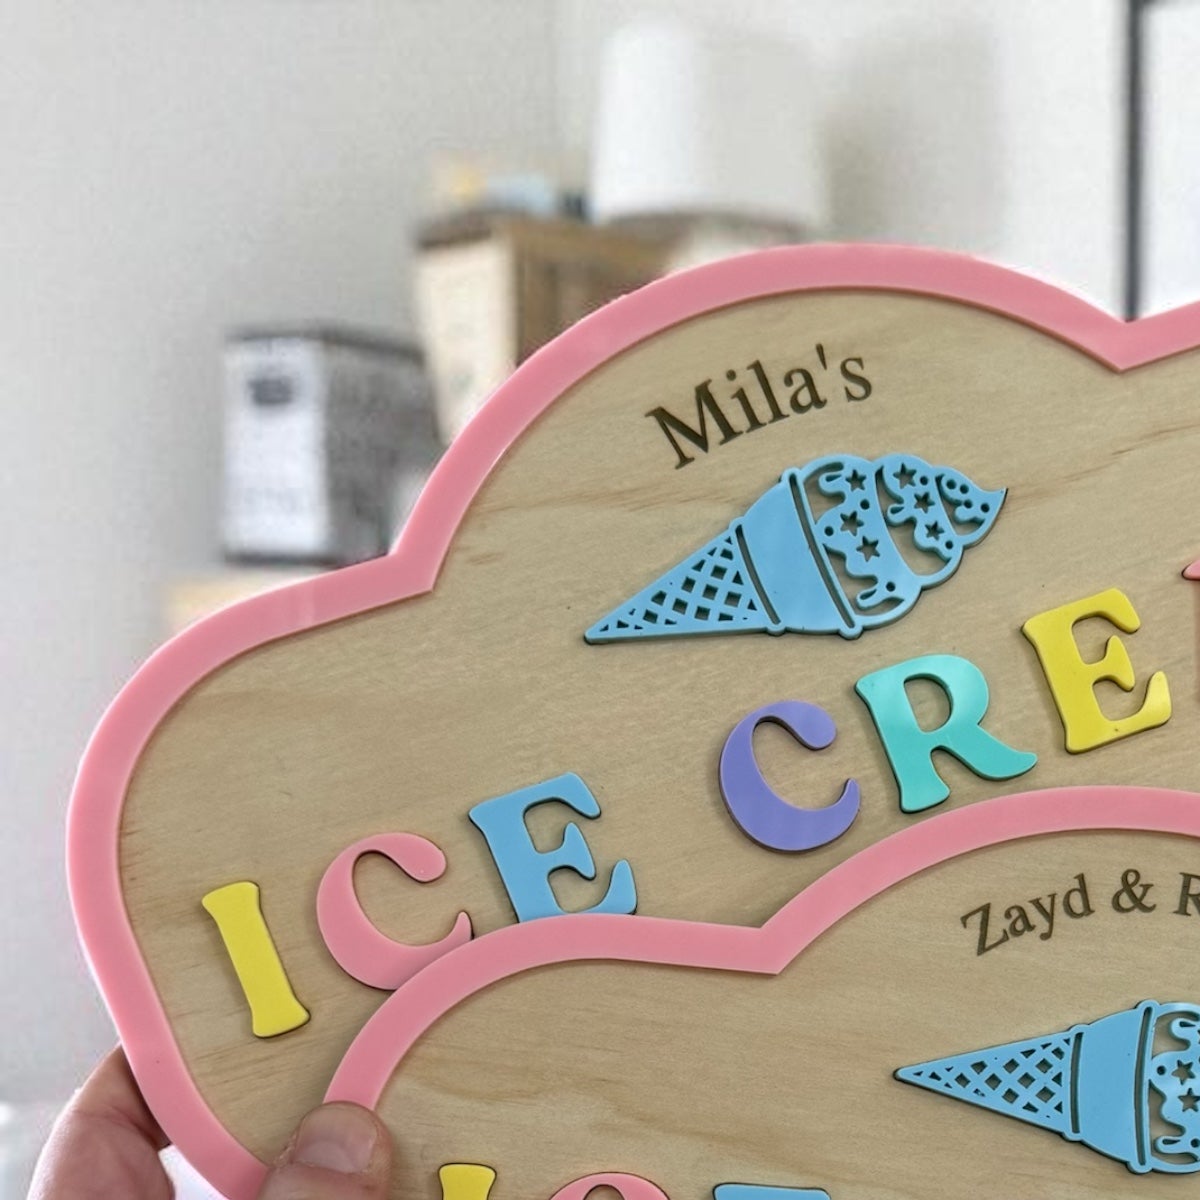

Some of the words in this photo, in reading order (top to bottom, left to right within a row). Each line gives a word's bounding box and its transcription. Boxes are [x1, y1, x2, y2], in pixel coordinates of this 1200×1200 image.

[644, 343, 873, 469] Mila's
[201, 771, 638, 1038] ICE
[961, 873, 1095, 957] Zayd
[1111, 868, 1157, 914] &
